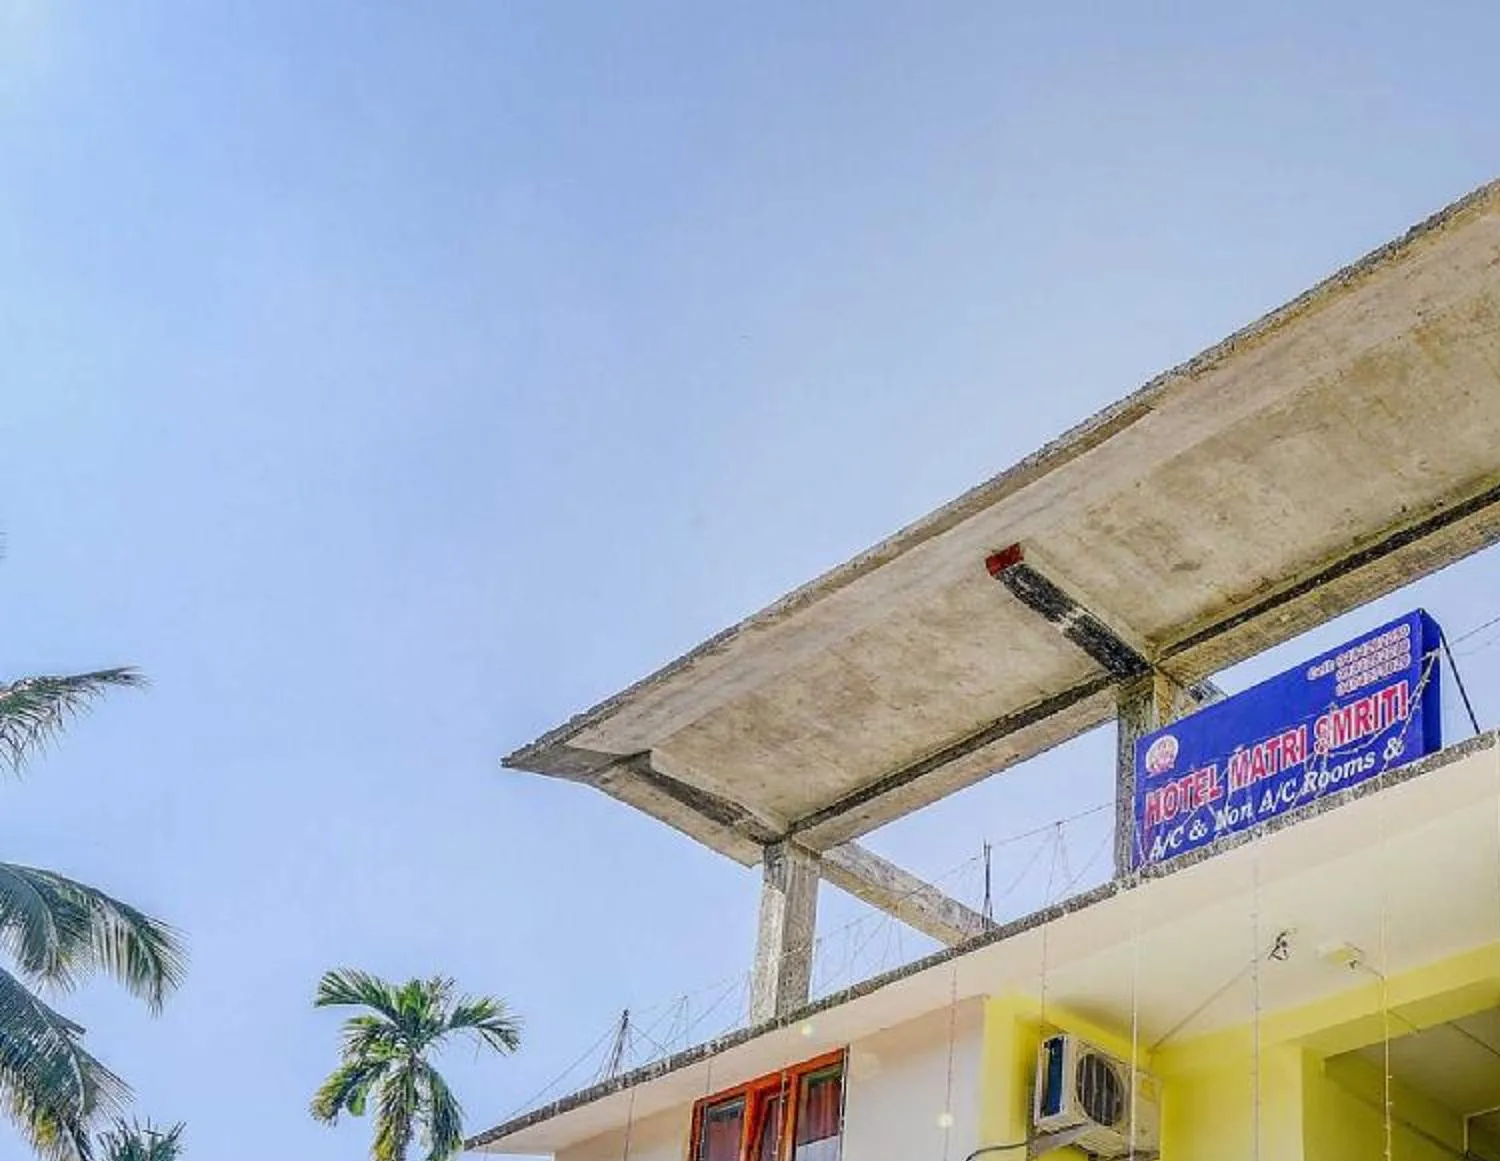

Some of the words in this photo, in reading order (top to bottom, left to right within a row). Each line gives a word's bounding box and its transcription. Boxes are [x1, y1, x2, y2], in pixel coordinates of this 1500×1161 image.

[1144, 764, 1223, 826] HOTEL
[1227, 724, 1307, 793] MATRI
[1313, 680, 1409, 755] SMRITI
[1150, 825, 1185, 861] A/C
[1189, 819, 1208, 841] &
[1214, 801, 1252, 832] Non
[1258, 778, 1297, 813] A/C
[1301, 751, 1376, 797] Rooms
[1382, 737, 1404, 760] &
